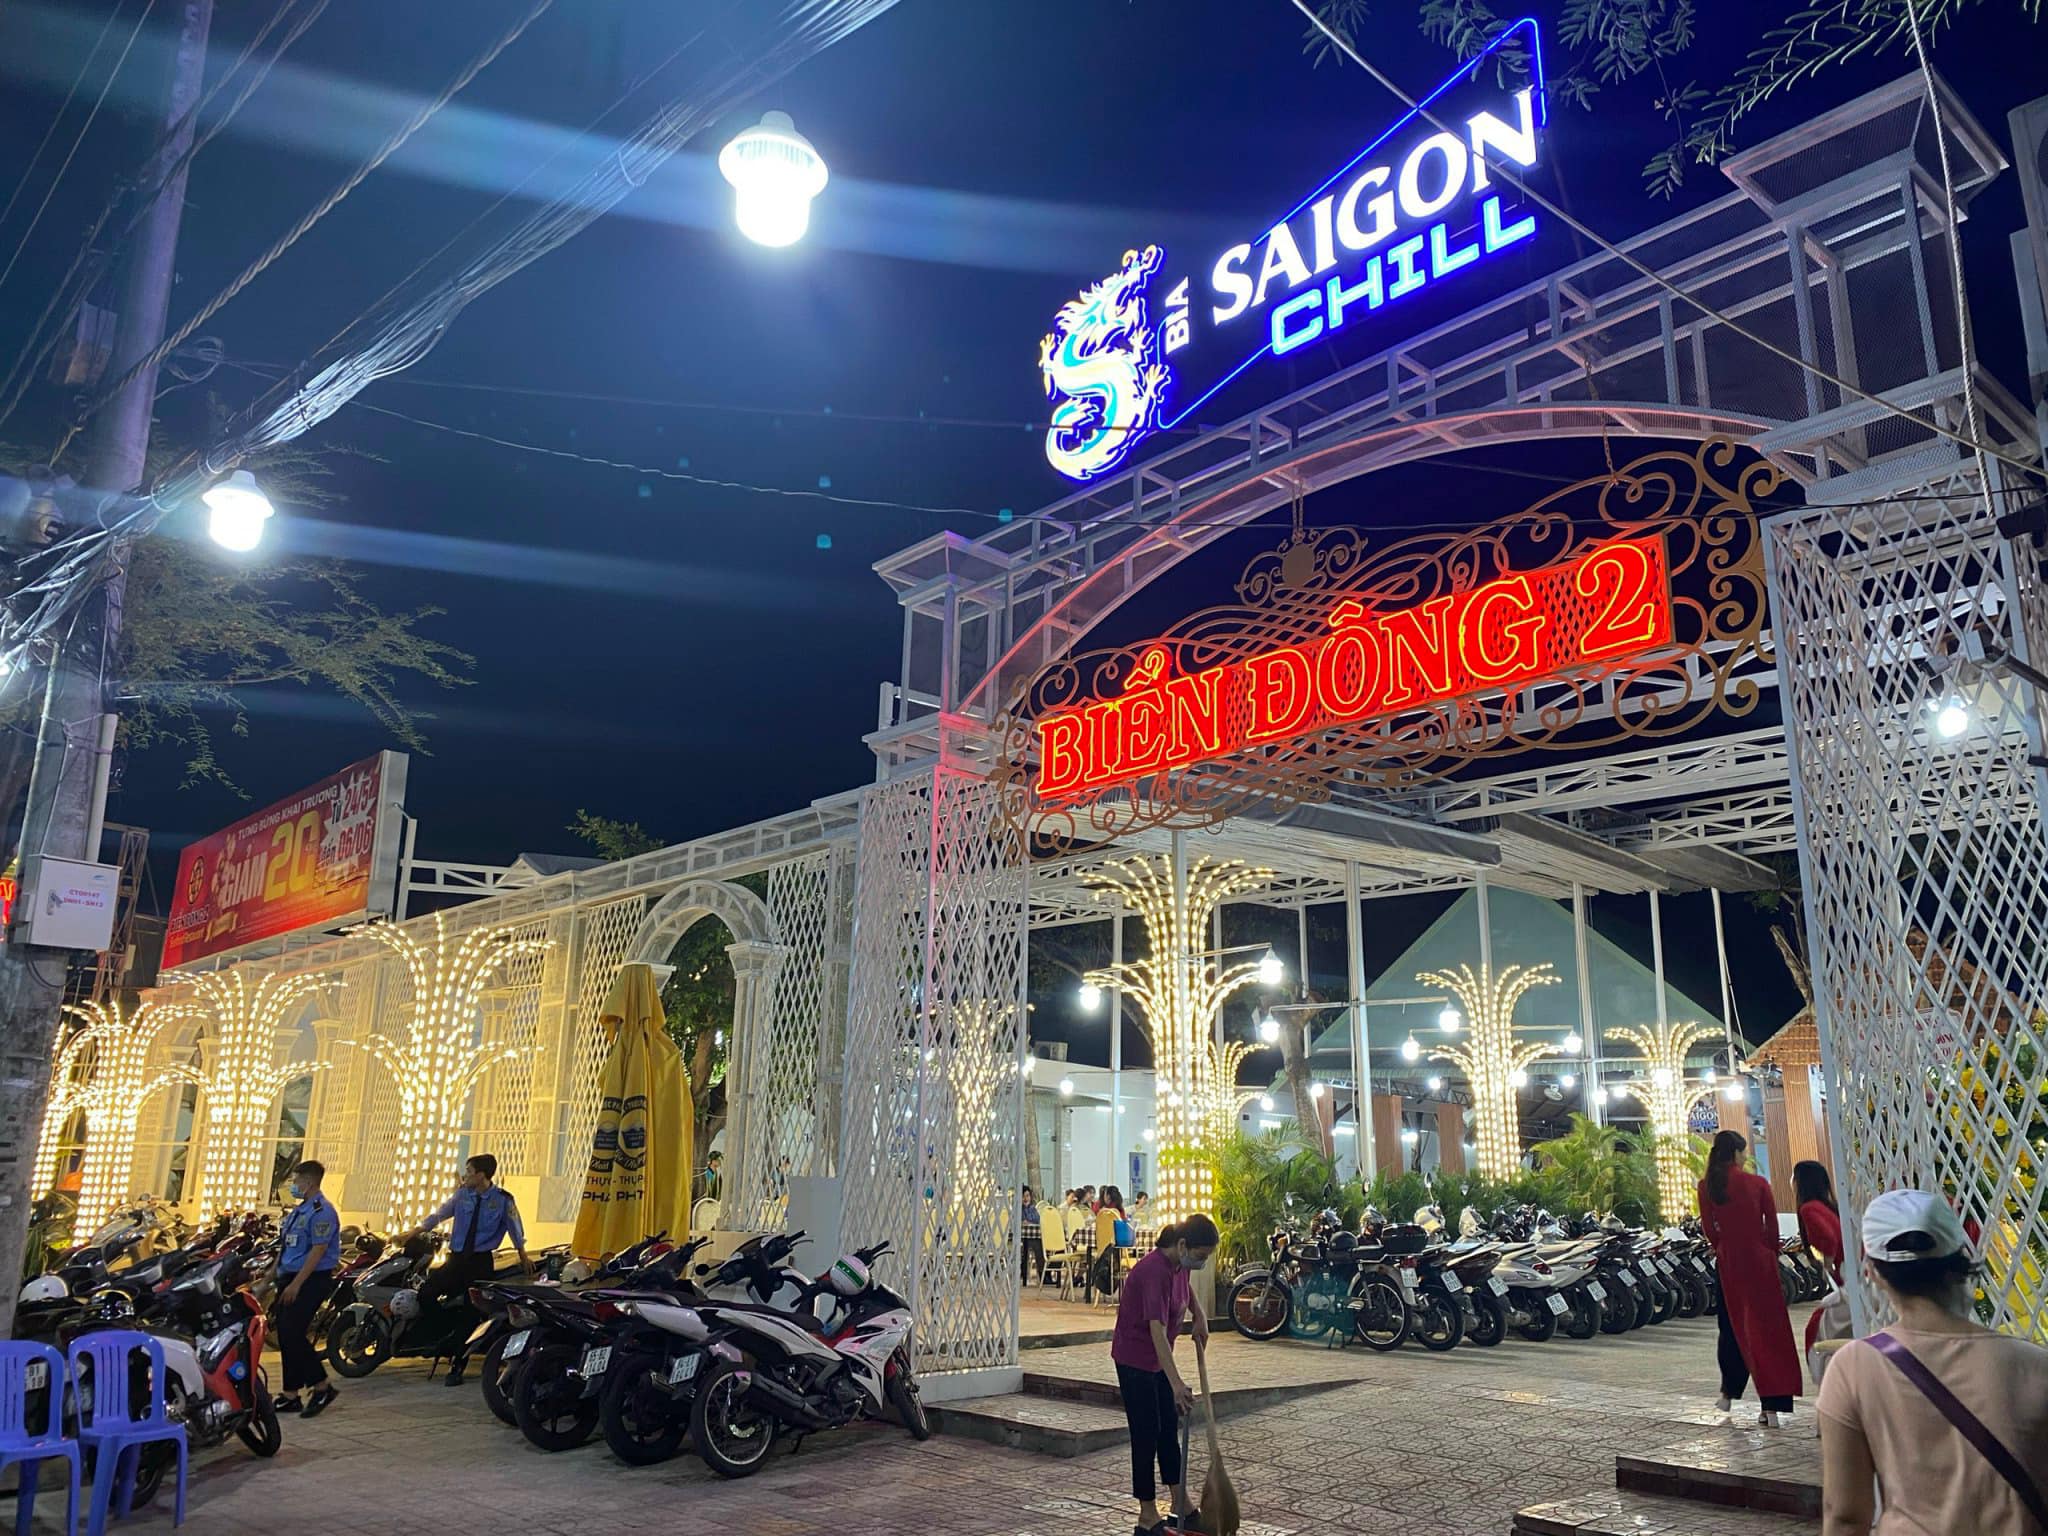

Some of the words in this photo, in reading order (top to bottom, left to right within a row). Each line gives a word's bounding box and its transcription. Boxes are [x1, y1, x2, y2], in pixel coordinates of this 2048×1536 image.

[1212, 86, 1538, 325] SAIGON
[1271, 196, 1536, 356] CHILL
[1165, 275, 1190, 355] BIA
[1036, 646, 1225, 797] BIỂN
[1246, 576, 1547, 740] ĐÔNG
[1576, 543, 1656, 657] 2
